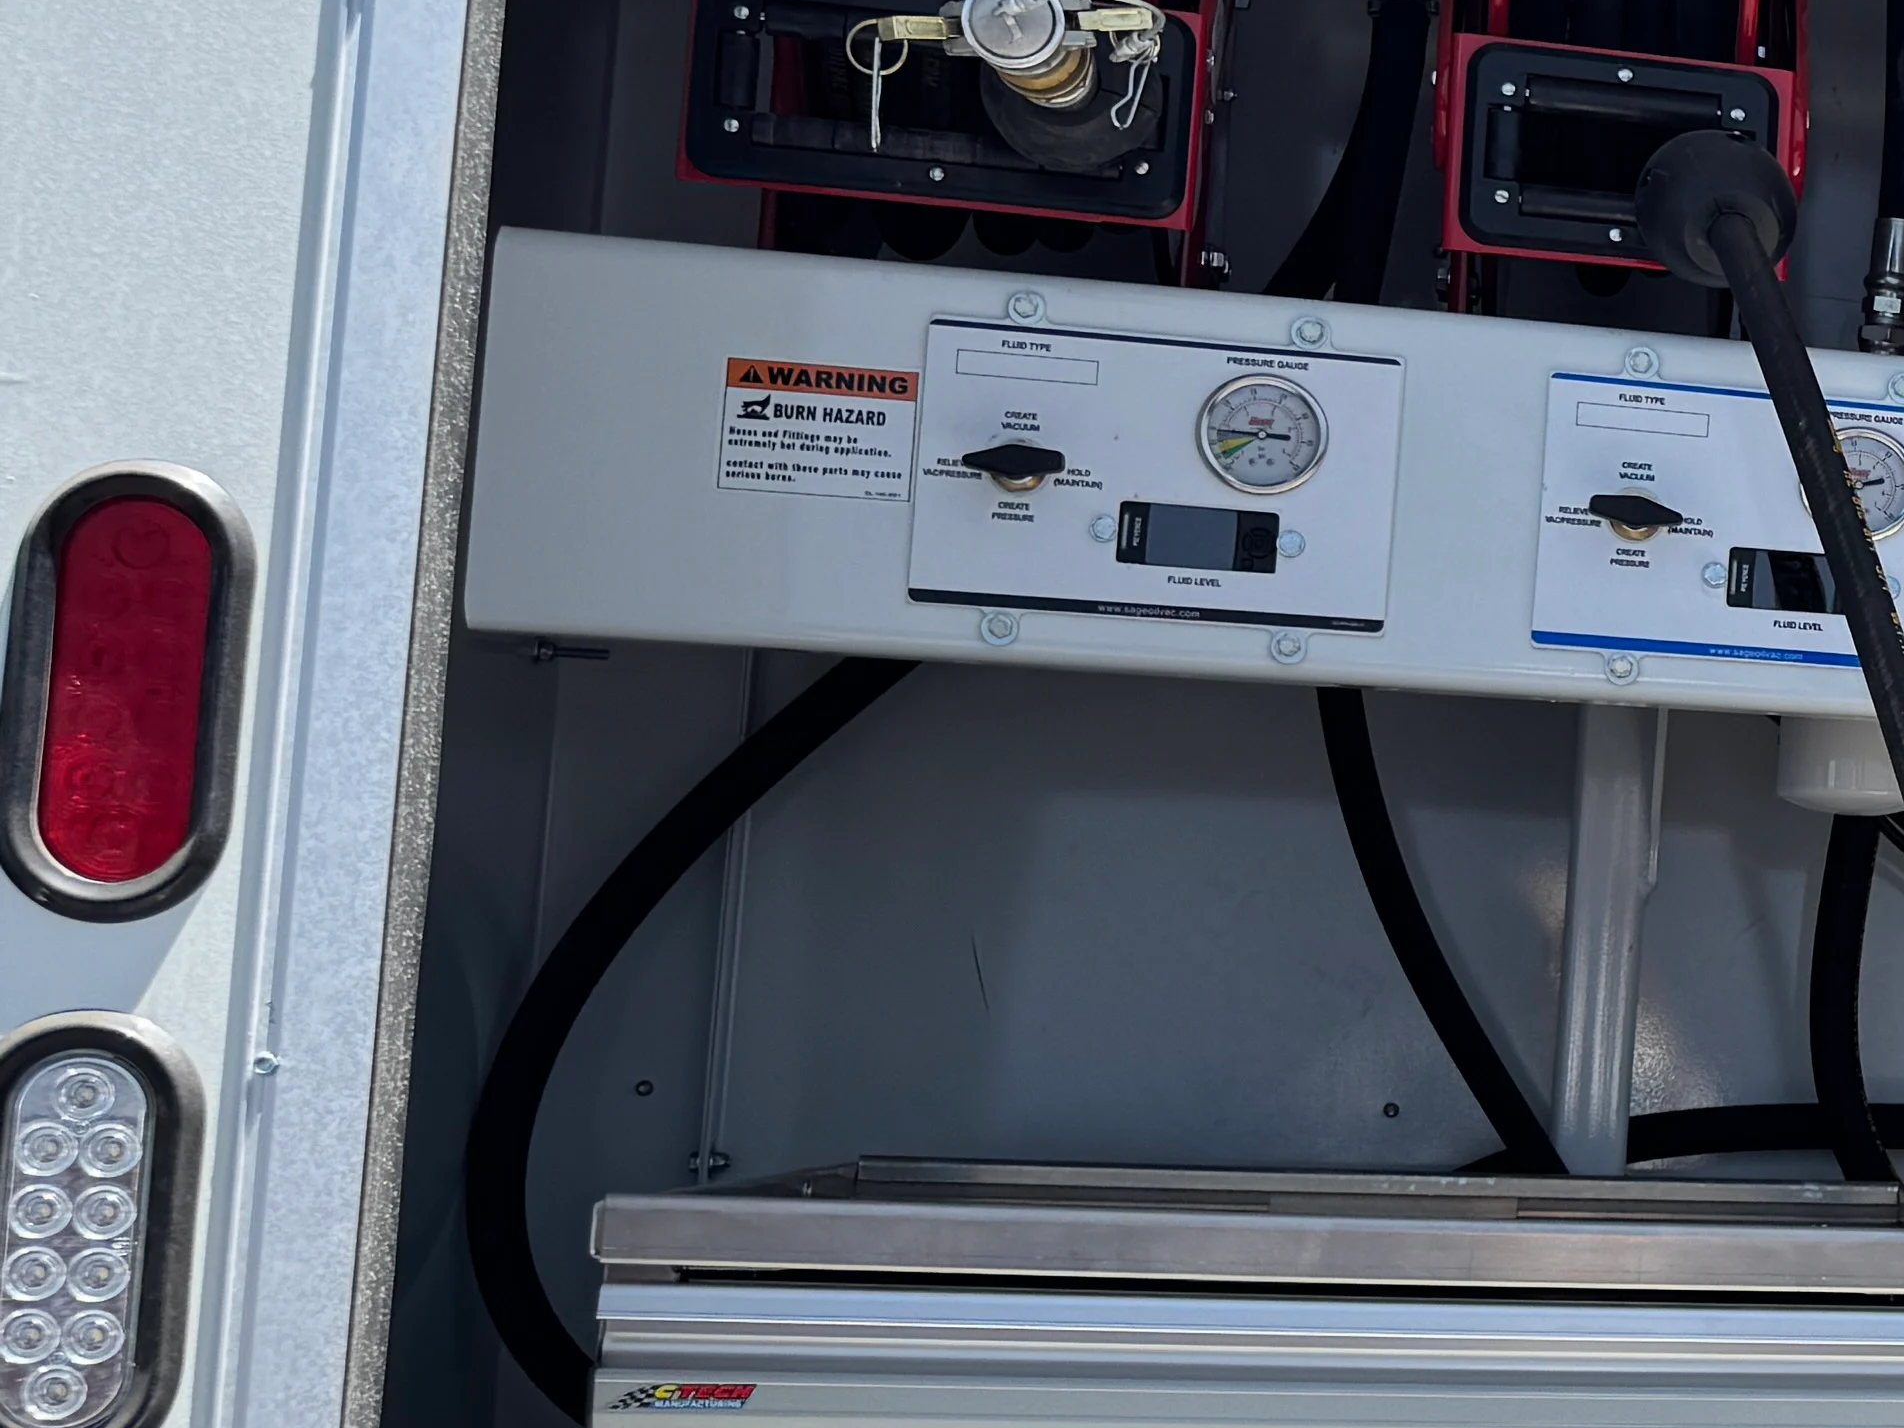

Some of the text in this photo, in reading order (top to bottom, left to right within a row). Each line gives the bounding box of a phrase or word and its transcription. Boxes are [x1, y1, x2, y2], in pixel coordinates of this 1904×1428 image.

[1001, 340, 1052, 352] FLUID TYPE
[1226, 356, 1309, 371] PRESSURE GAUGE
[768, 366, 908, 394] WARNING
[1619, 393, 1666, 406] FLUID TYPE
[773, 403, 887, 426] BURN HAZARD
[1004, 410, 1038, 421] CREATE
[1874, 416, 1903, 425] GAUGE
[1000, 422, 1041, 432] VACUUM
[729, 426, 758, 437] Hoses
[762, 429, 778, 439] and
[824, 435, 843, 445] may
[847, 435, 858, 445] be
[728, 438, 892, 458] extremely hot during application.
[726, 459, 902, 480] contact with these parts may cause
[1066, 468, 1091, 477] HOLD
[725, 470, 796, 482] serious burns.
[1053, 478, 1103, 490] (MAINTAIN)
[997, 501, 1030, 512] CREATE
[991, 512, 1034, 523] PRESSURE
[1167, 575, 1221, 588] FLUID LEVEL
[1773, 620, 1823, 632] FLUID LEVEL
[655, 1400, 742, 1408] MANUFACTURING
